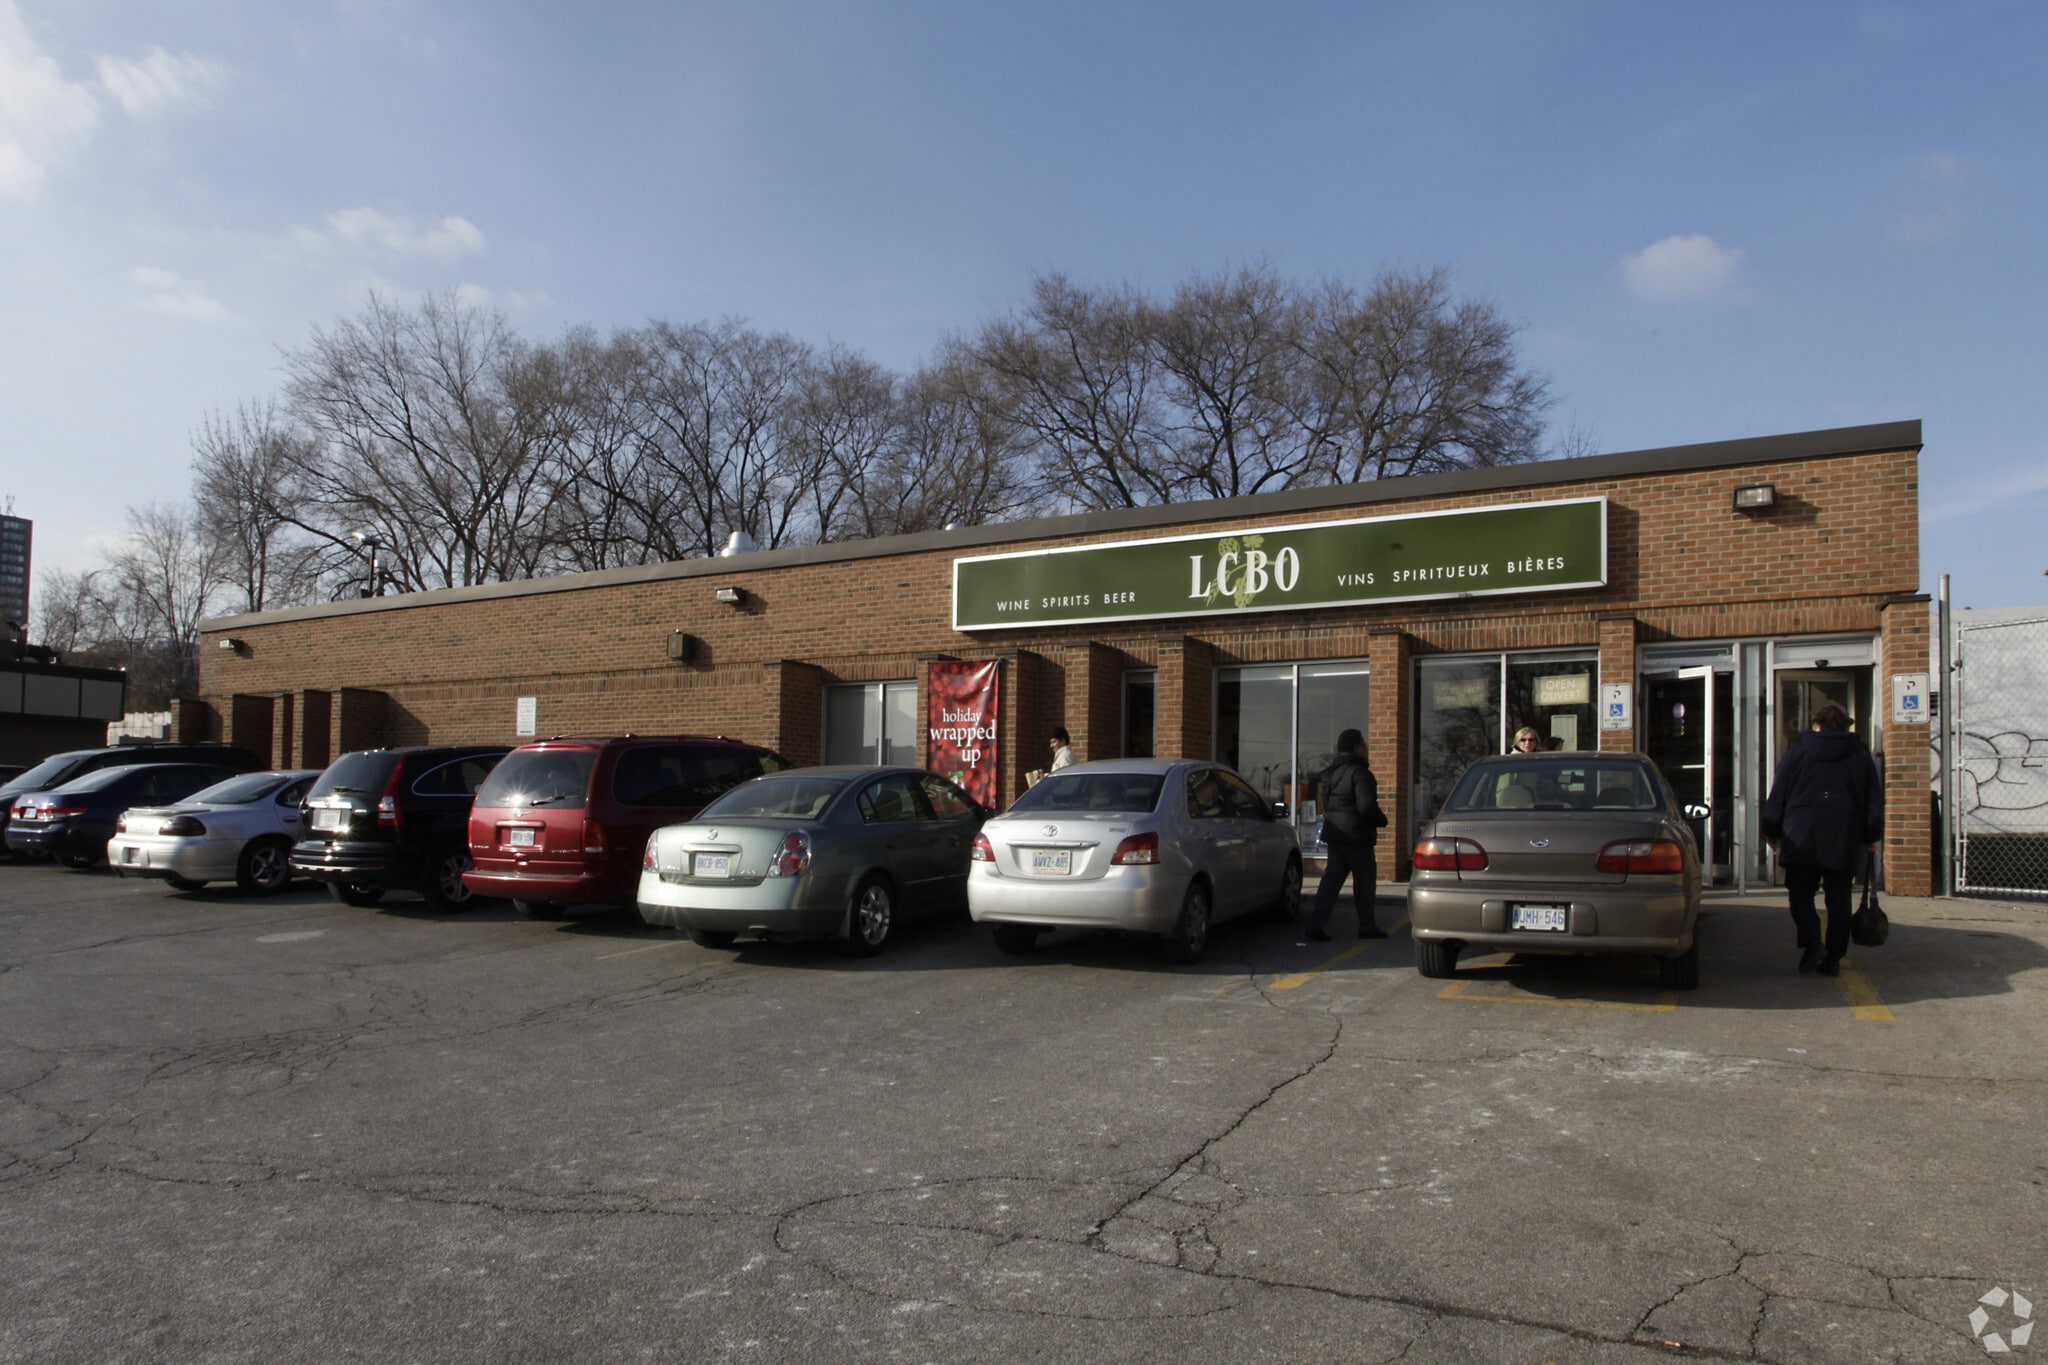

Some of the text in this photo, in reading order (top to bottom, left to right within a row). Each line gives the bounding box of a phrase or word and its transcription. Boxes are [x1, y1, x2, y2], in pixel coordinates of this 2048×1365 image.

[1188, 546, 1300, 598] LCBO
[1337, 556, 1565, 586] VINS SPIRITUEUX BIÈRES
[996, 592, 1136, 612] WINE SPIRITS BEER
[1542, 689, 1581, 701] OUVERT
[1546, 680, 1576, 690] OPEN
[942, 708, 982, 726] holiday
[930, 719, 996, 747] wrapped
[961, 748, 982, 769] up
[1544, 910, 1564, 926] 546
